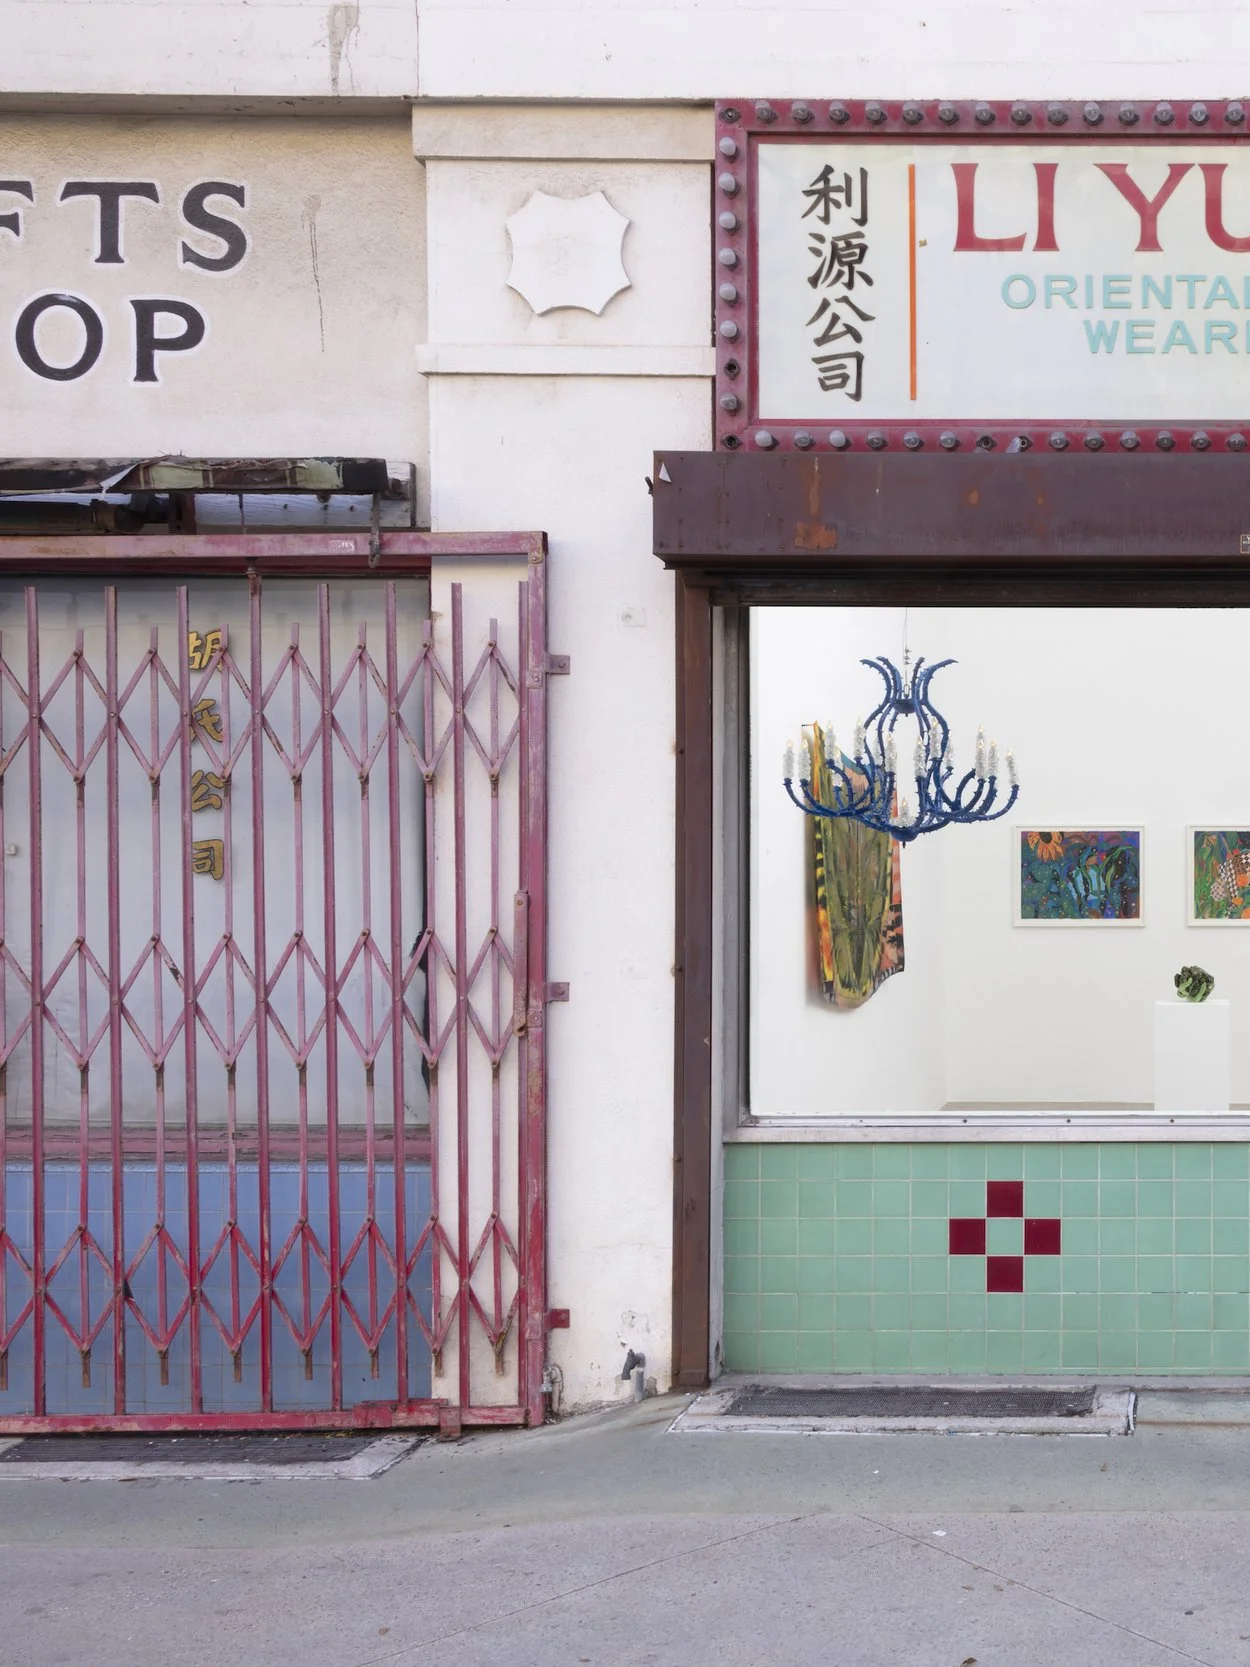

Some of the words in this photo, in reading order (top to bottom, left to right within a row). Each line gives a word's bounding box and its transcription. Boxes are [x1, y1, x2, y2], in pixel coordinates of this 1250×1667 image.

[951, 163, 1060, 252] LI
[802, 164, 876, 402] 利源公司
[14, 293, 207, 383] OP
